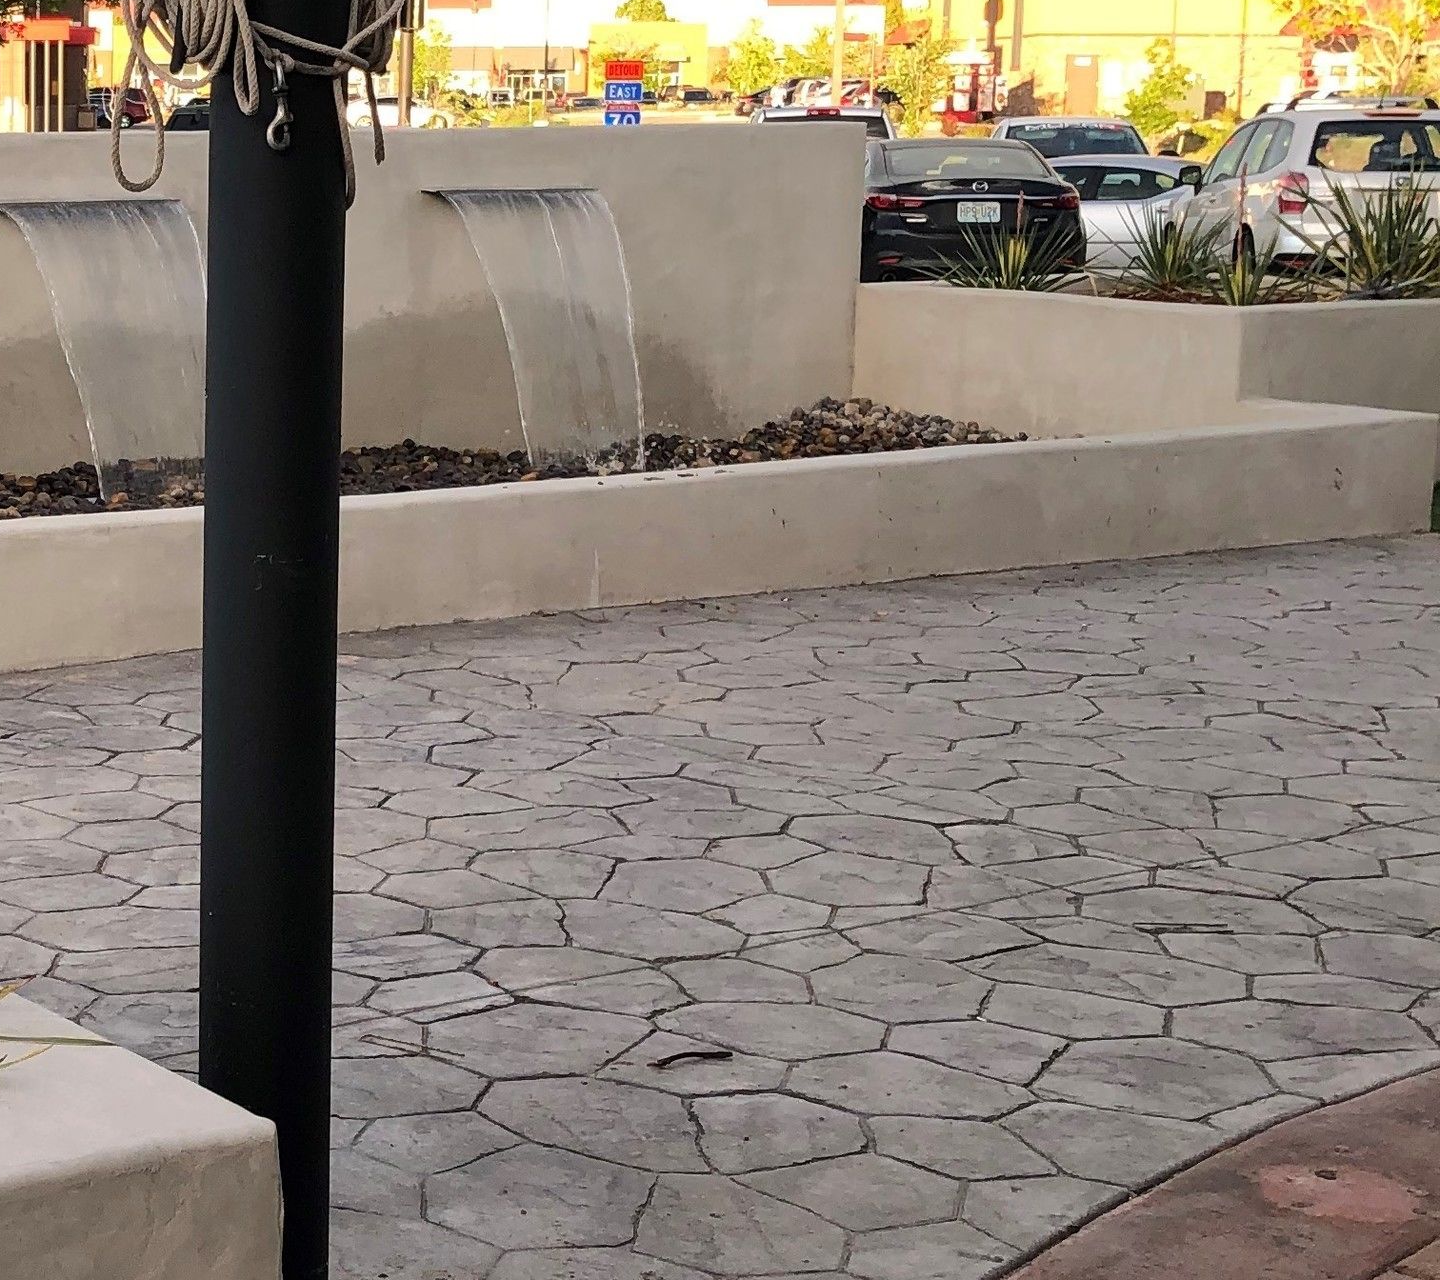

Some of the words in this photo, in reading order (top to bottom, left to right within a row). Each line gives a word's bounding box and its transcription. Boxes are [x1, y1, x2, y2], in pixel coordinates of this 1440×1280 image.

[609, 64, 640, 76] DETOUR
[609, 85, 637, 98] EAST
[609, 113, 636, 126] 70
